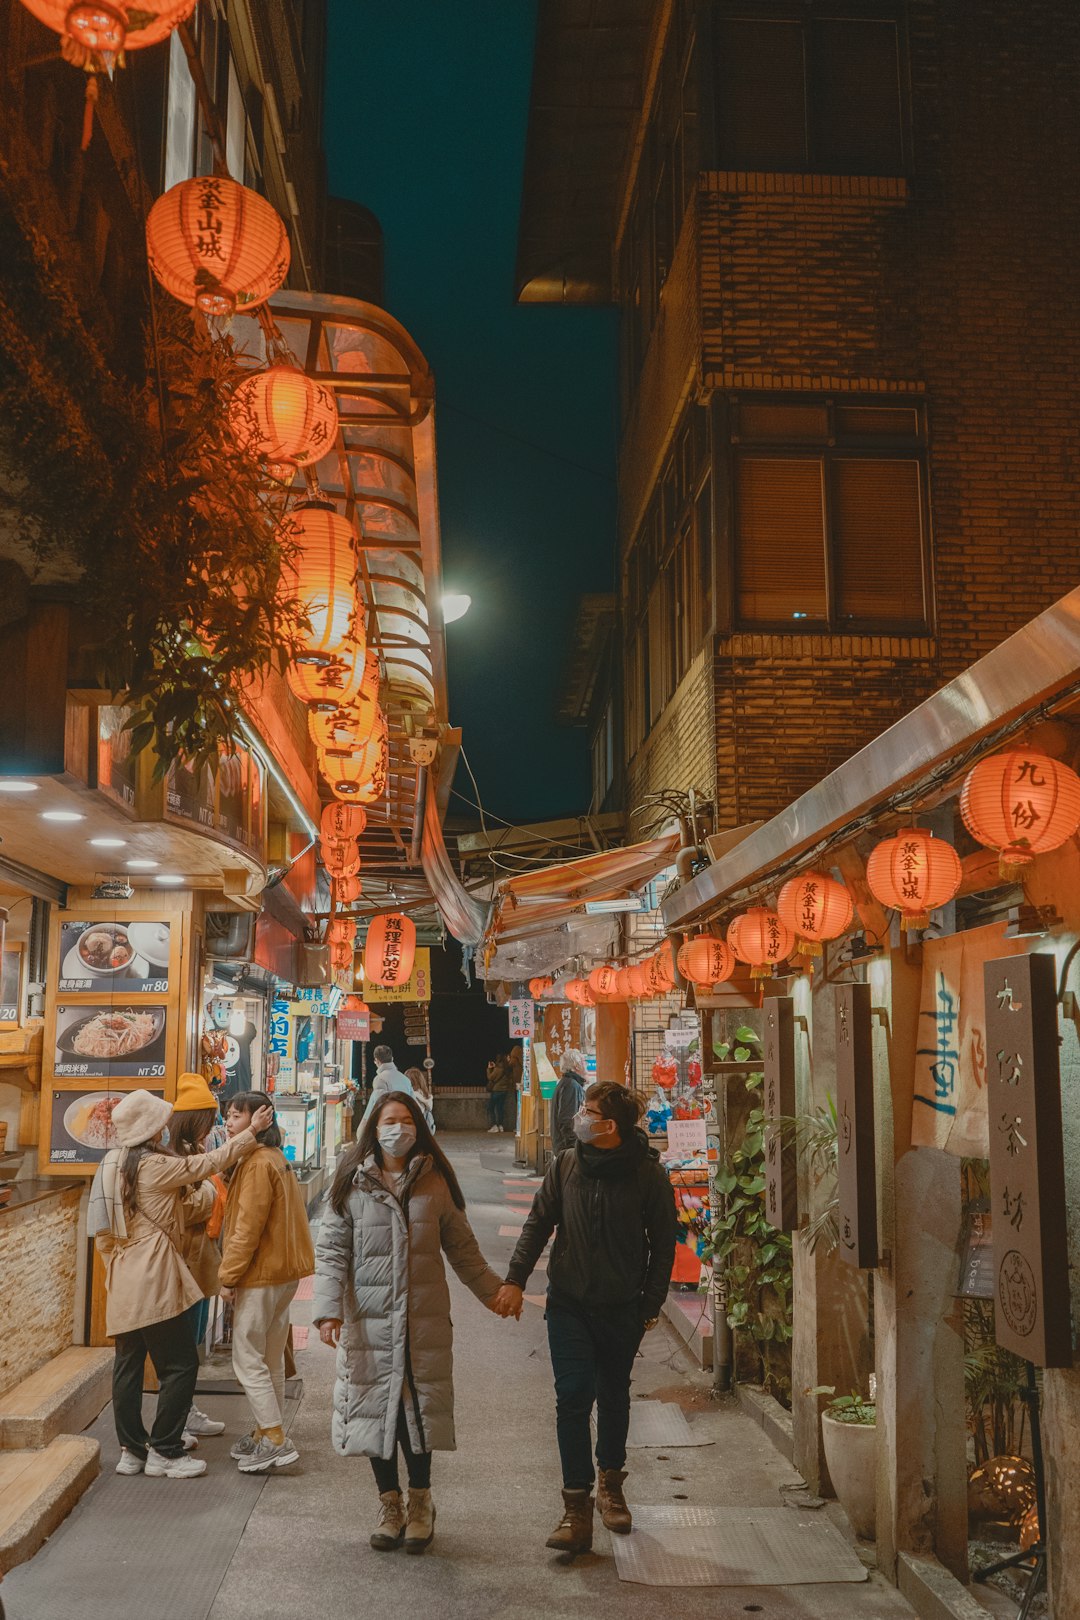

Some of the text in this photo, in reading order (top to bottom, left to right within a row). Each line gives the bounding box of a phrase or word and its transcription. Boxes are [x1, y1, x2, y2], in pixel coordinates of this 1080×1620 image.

[194, 178, 227, 262] 黃金山城
[1011, 760, 1047, 830] 九份
[900, 842, 922, 900] 黃金山城
[801, 882, 818, 934] 黃金山城
[766, 917, 781, 959] 黃金山城
[141, 980, 169, 992] NT 80
[137, 1064, 165, 1076] NT 50
